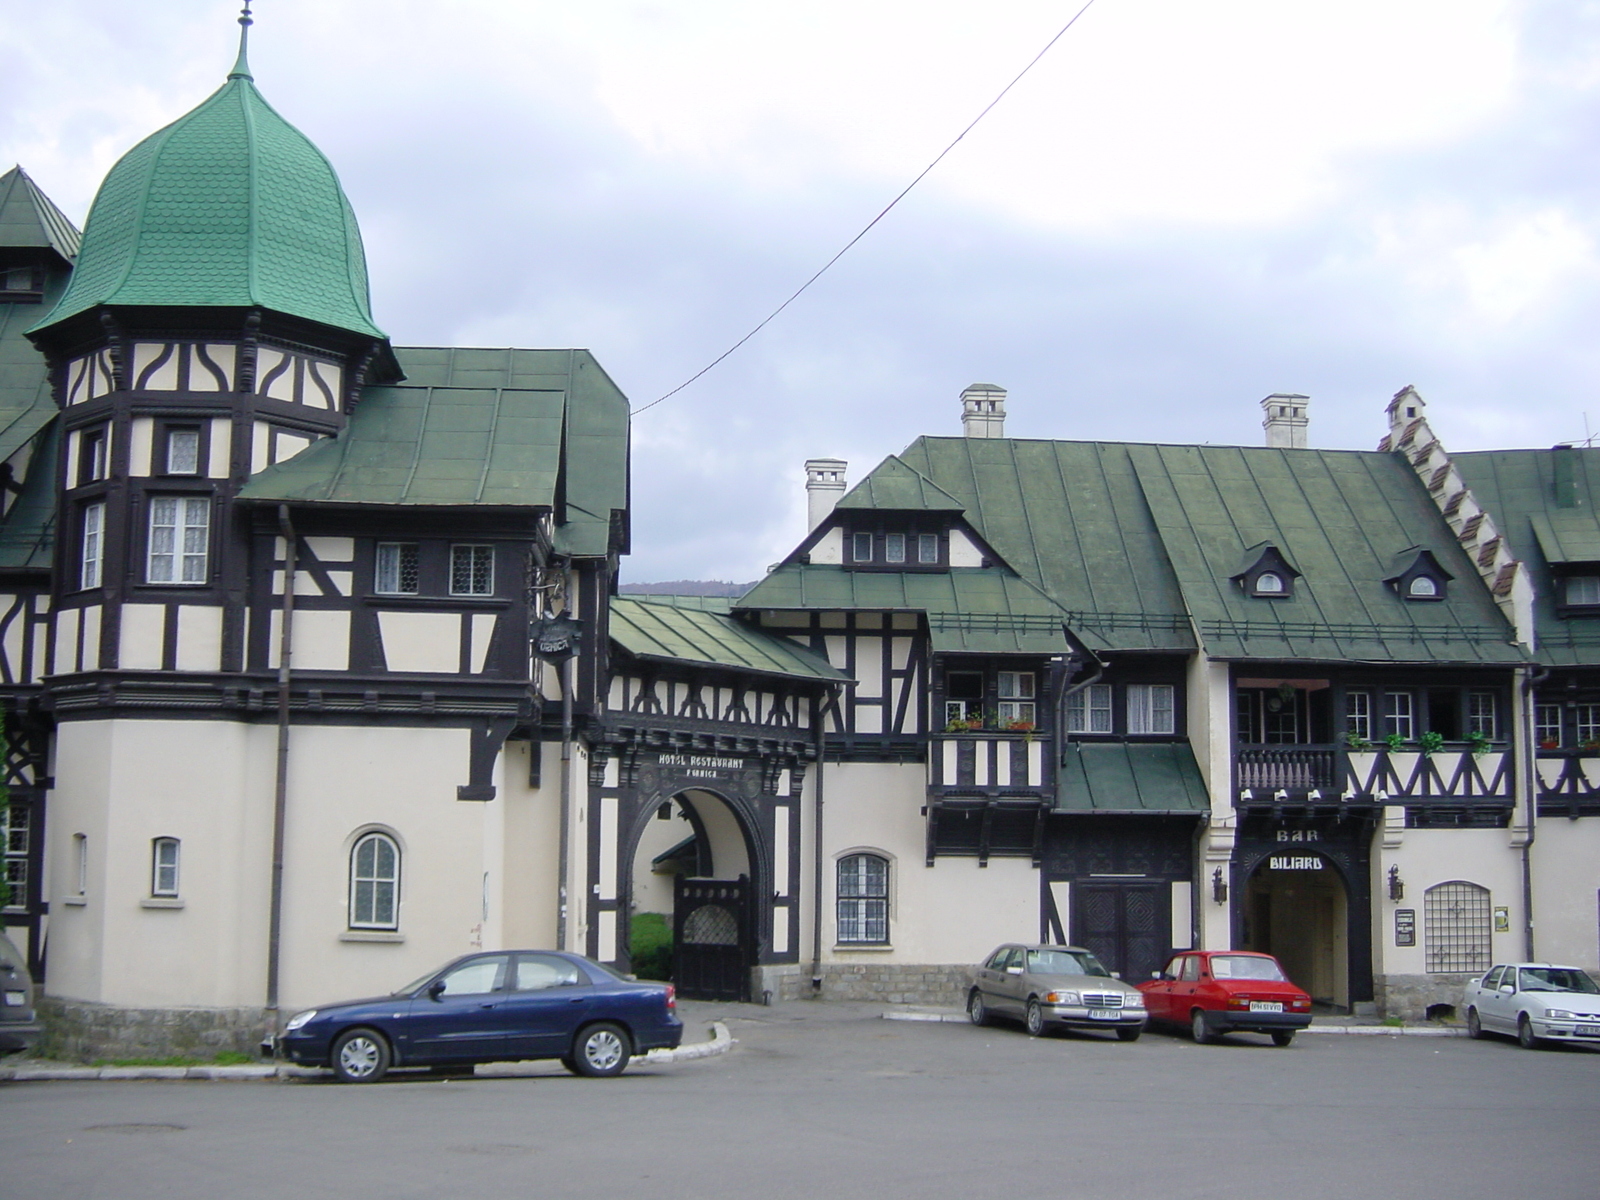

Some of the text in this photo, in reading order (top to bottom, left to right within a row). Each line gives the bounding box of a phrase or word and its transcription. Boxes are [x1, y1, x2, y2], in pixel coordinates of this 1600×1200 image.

[658, 754, 744, 769] HOTEL RESTAURANT
[1276, 829, 1319, 842] BAR
[1269, 856, 1323, 870] BILIARD
